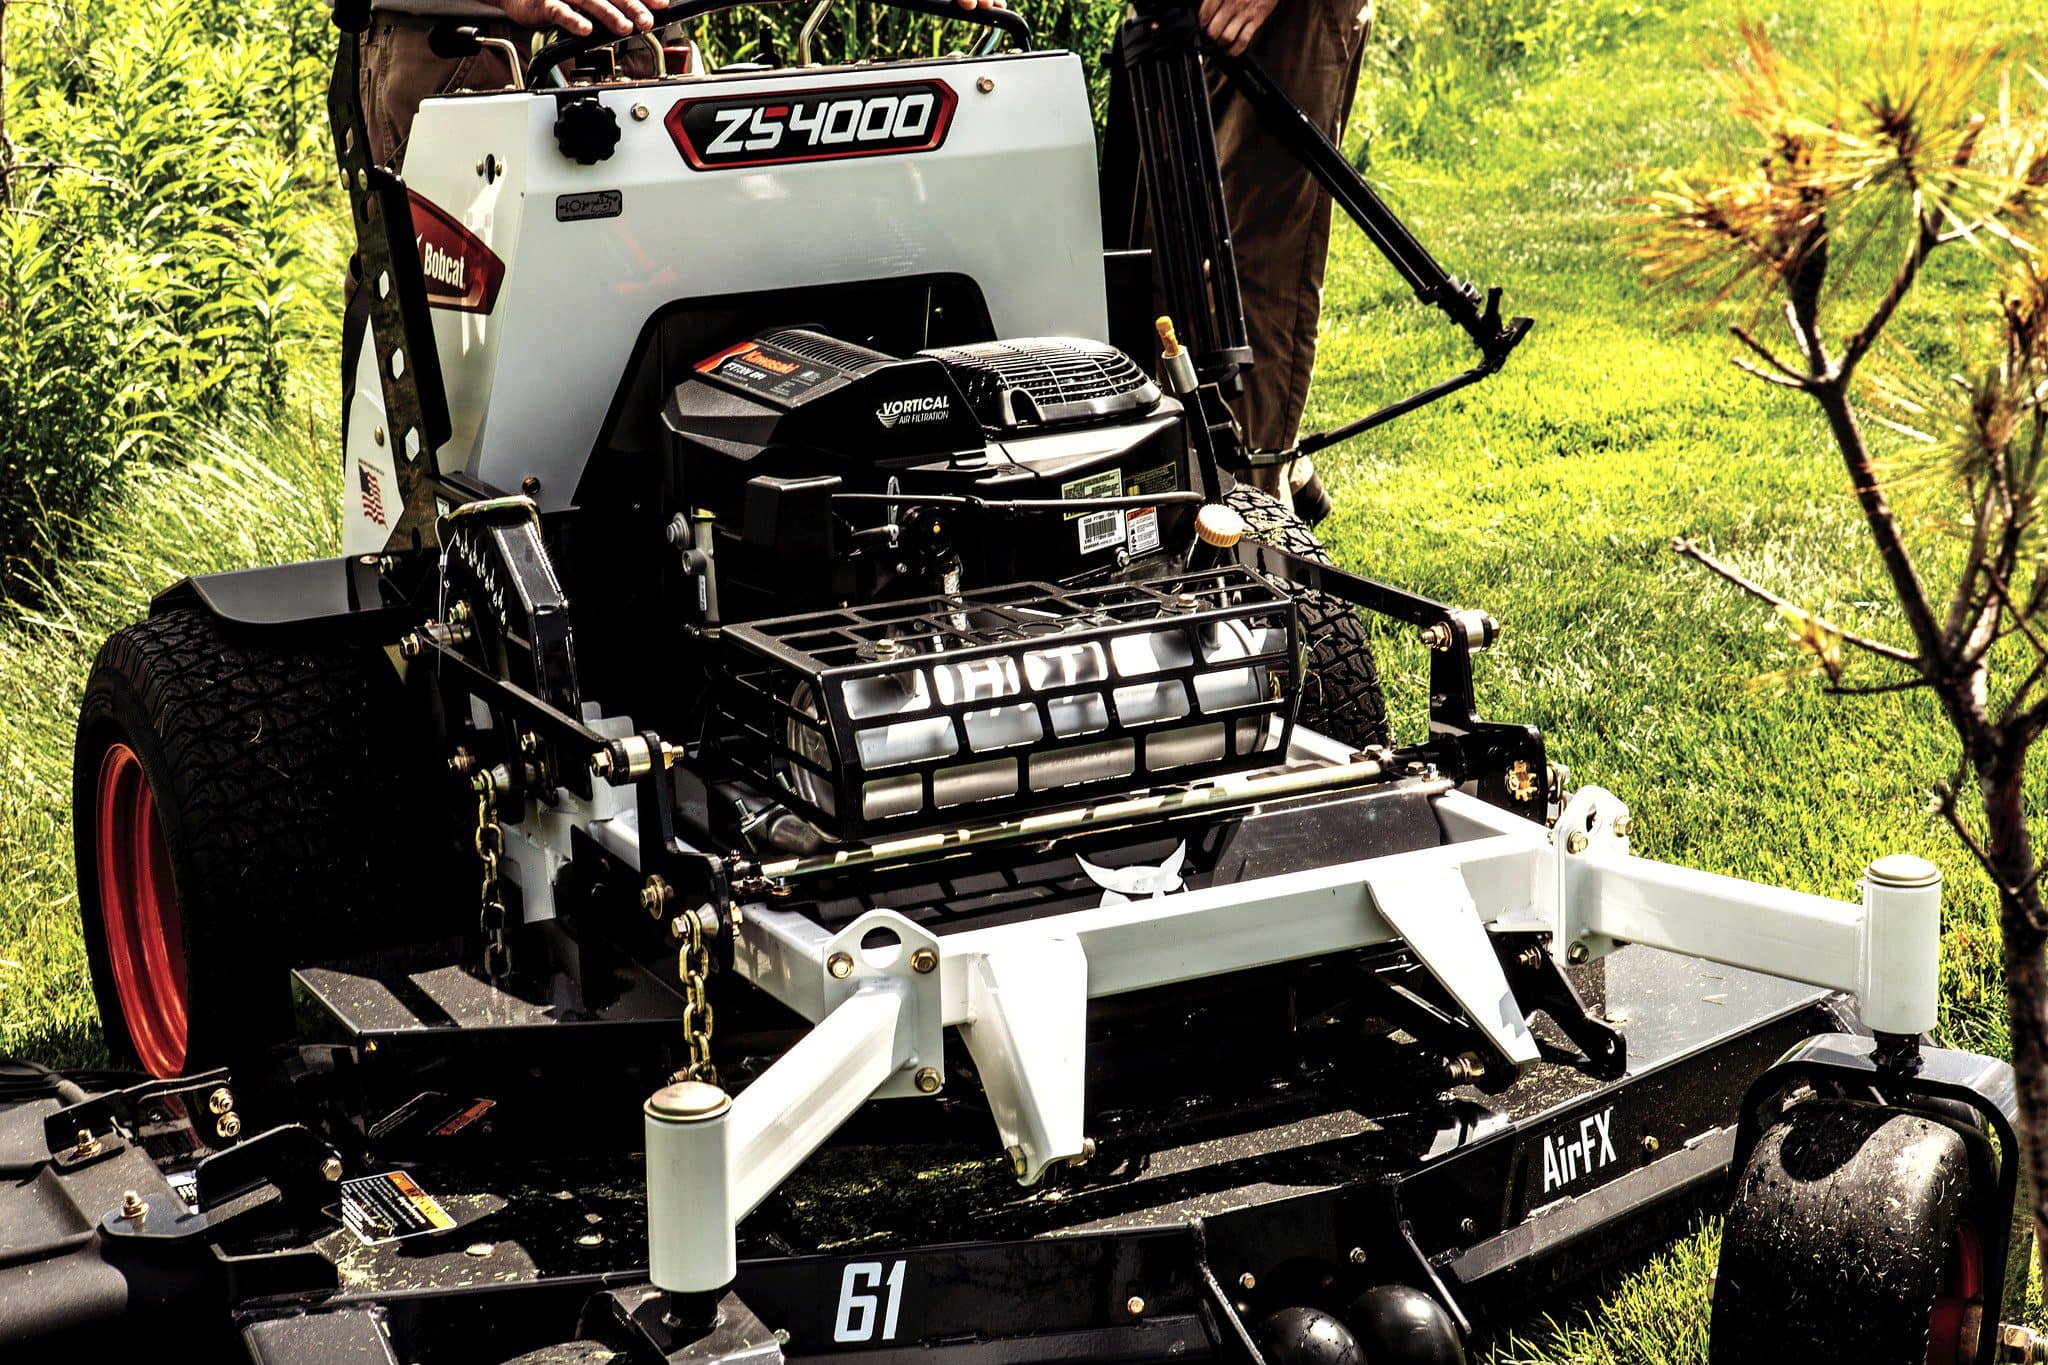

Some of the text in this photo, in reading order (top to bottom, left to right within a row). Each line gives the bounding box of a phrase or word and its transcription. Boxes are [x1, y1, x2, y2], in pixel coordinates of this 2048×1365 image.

[706, 93, 935, 155] ZS4000
[424, 242, 465, 290] Bobcat
[883, 395, 950, 415] VORTICAL
[899, 411, 949, 425] AIR FILTRATION
[1543, 1106, 1617, 1193] AirFX
[834, 1260, 907, 1342] 61
